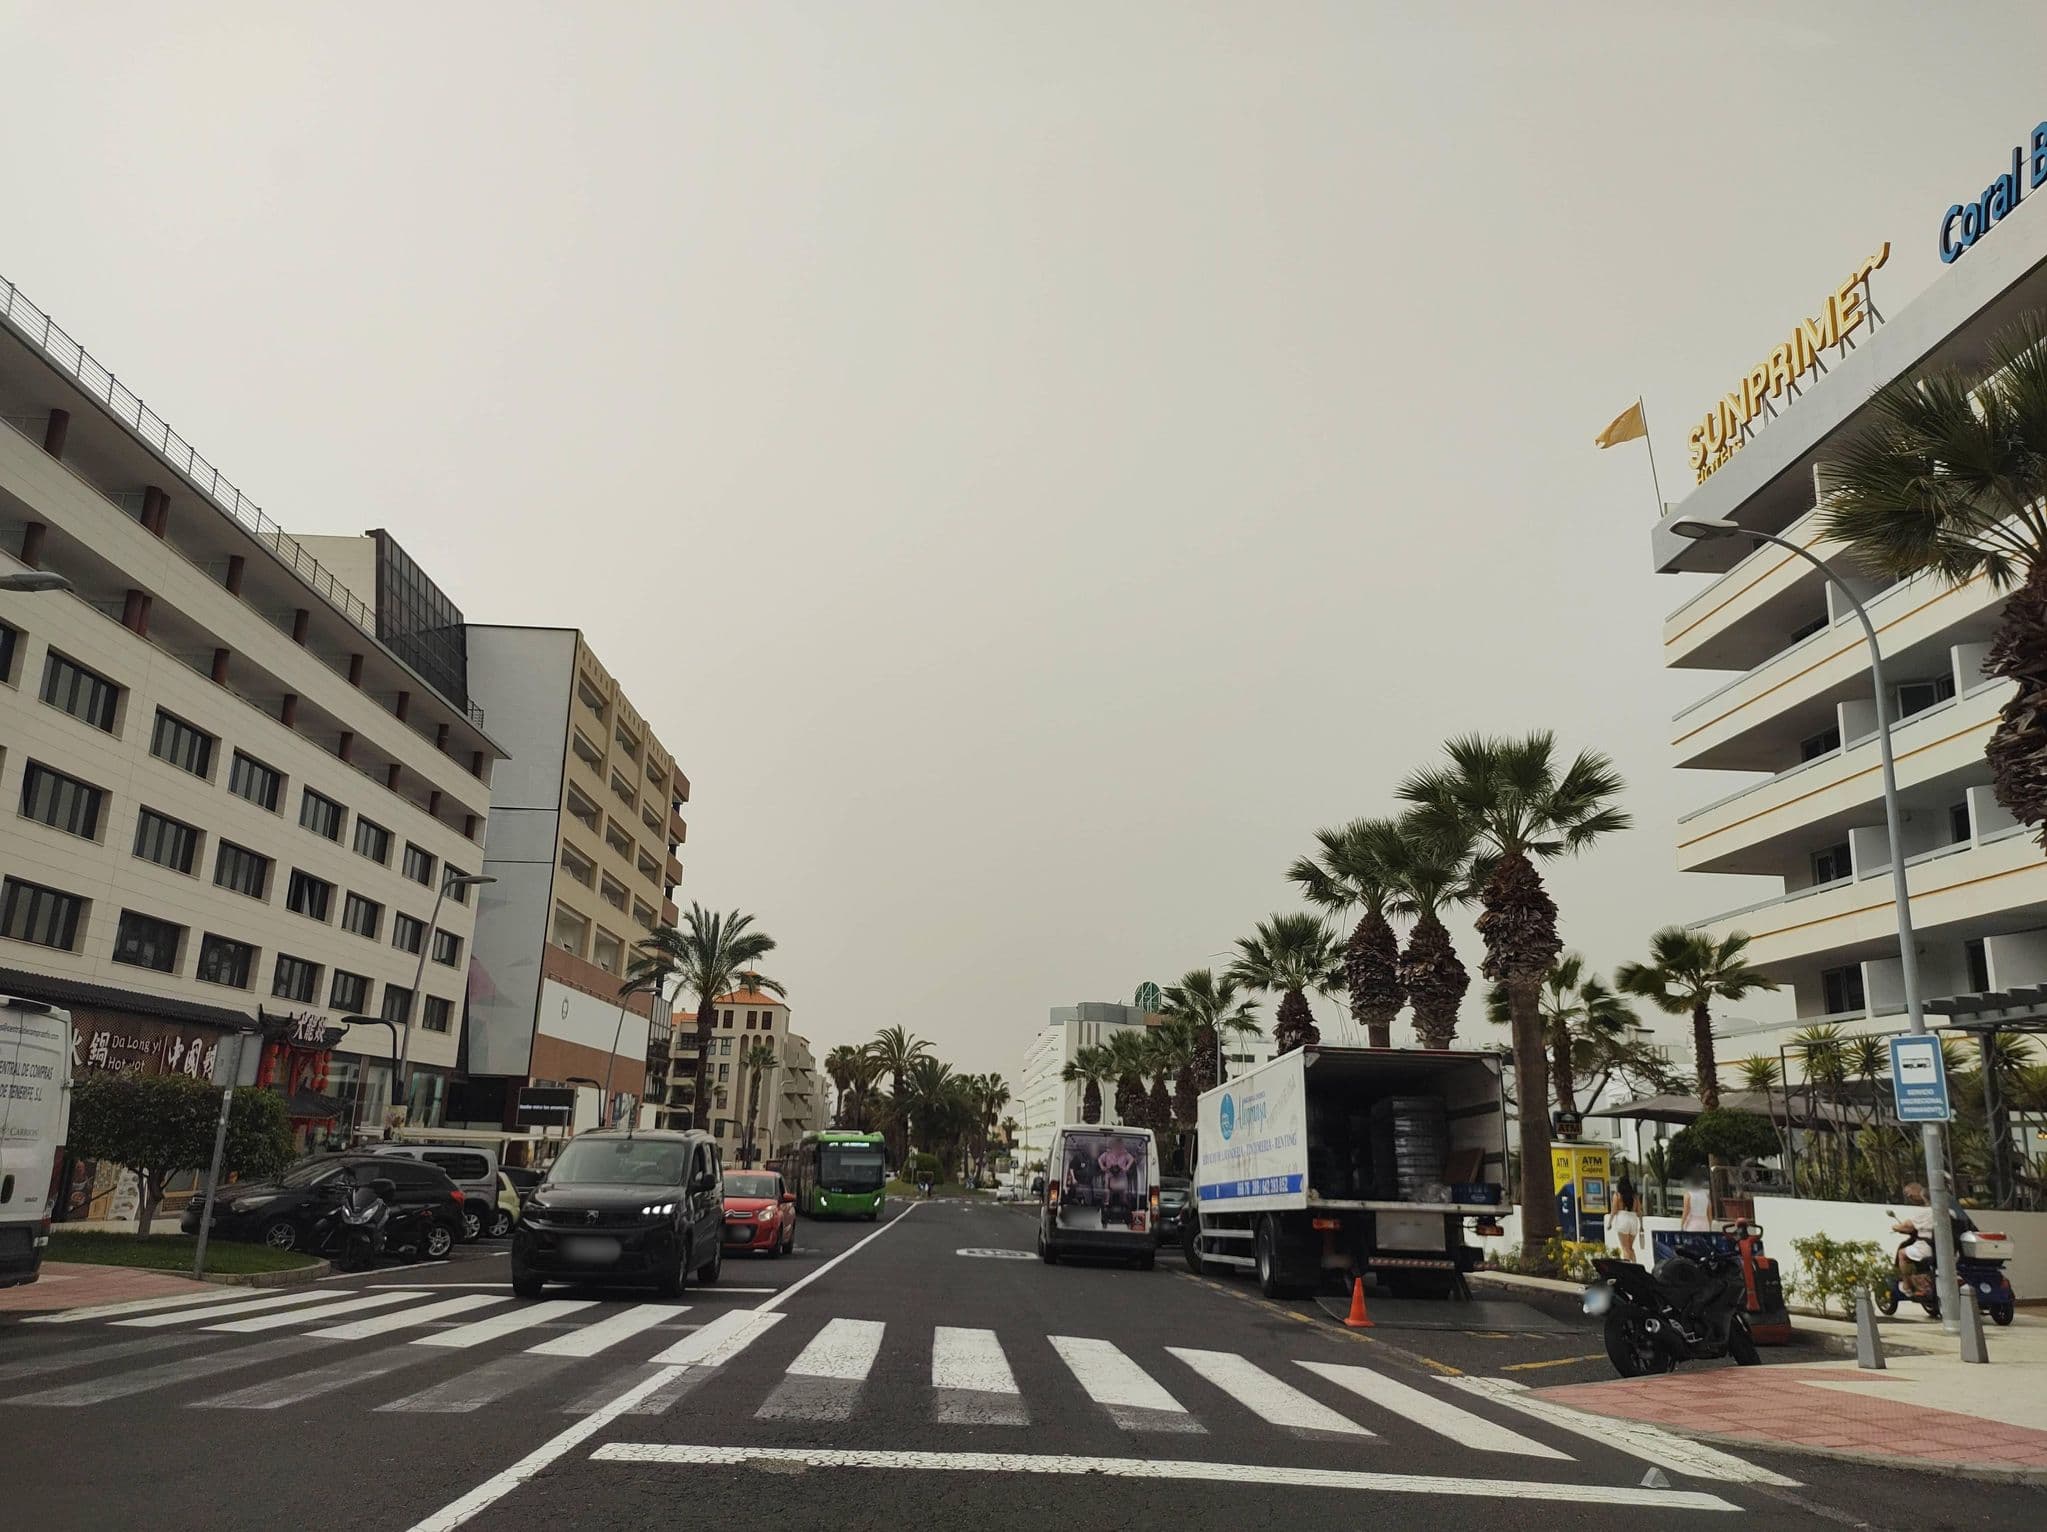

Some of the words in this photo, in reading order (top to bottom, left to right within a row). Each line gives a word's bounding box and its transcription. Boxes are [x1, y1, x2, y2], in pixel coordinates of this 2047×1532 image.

[1939, 146, 2022, 264] Coral
[1687, 266, 1866, 471] SUNPRIME
[112, 1035, 125, 1049] Da
[127, 1036, 150, 1053] Long
[107, 1056, 126, 1071] Hot
[1557, 1157, 1569, 1168] ATM
[1582, 1156, 1602, 1166] ATM
